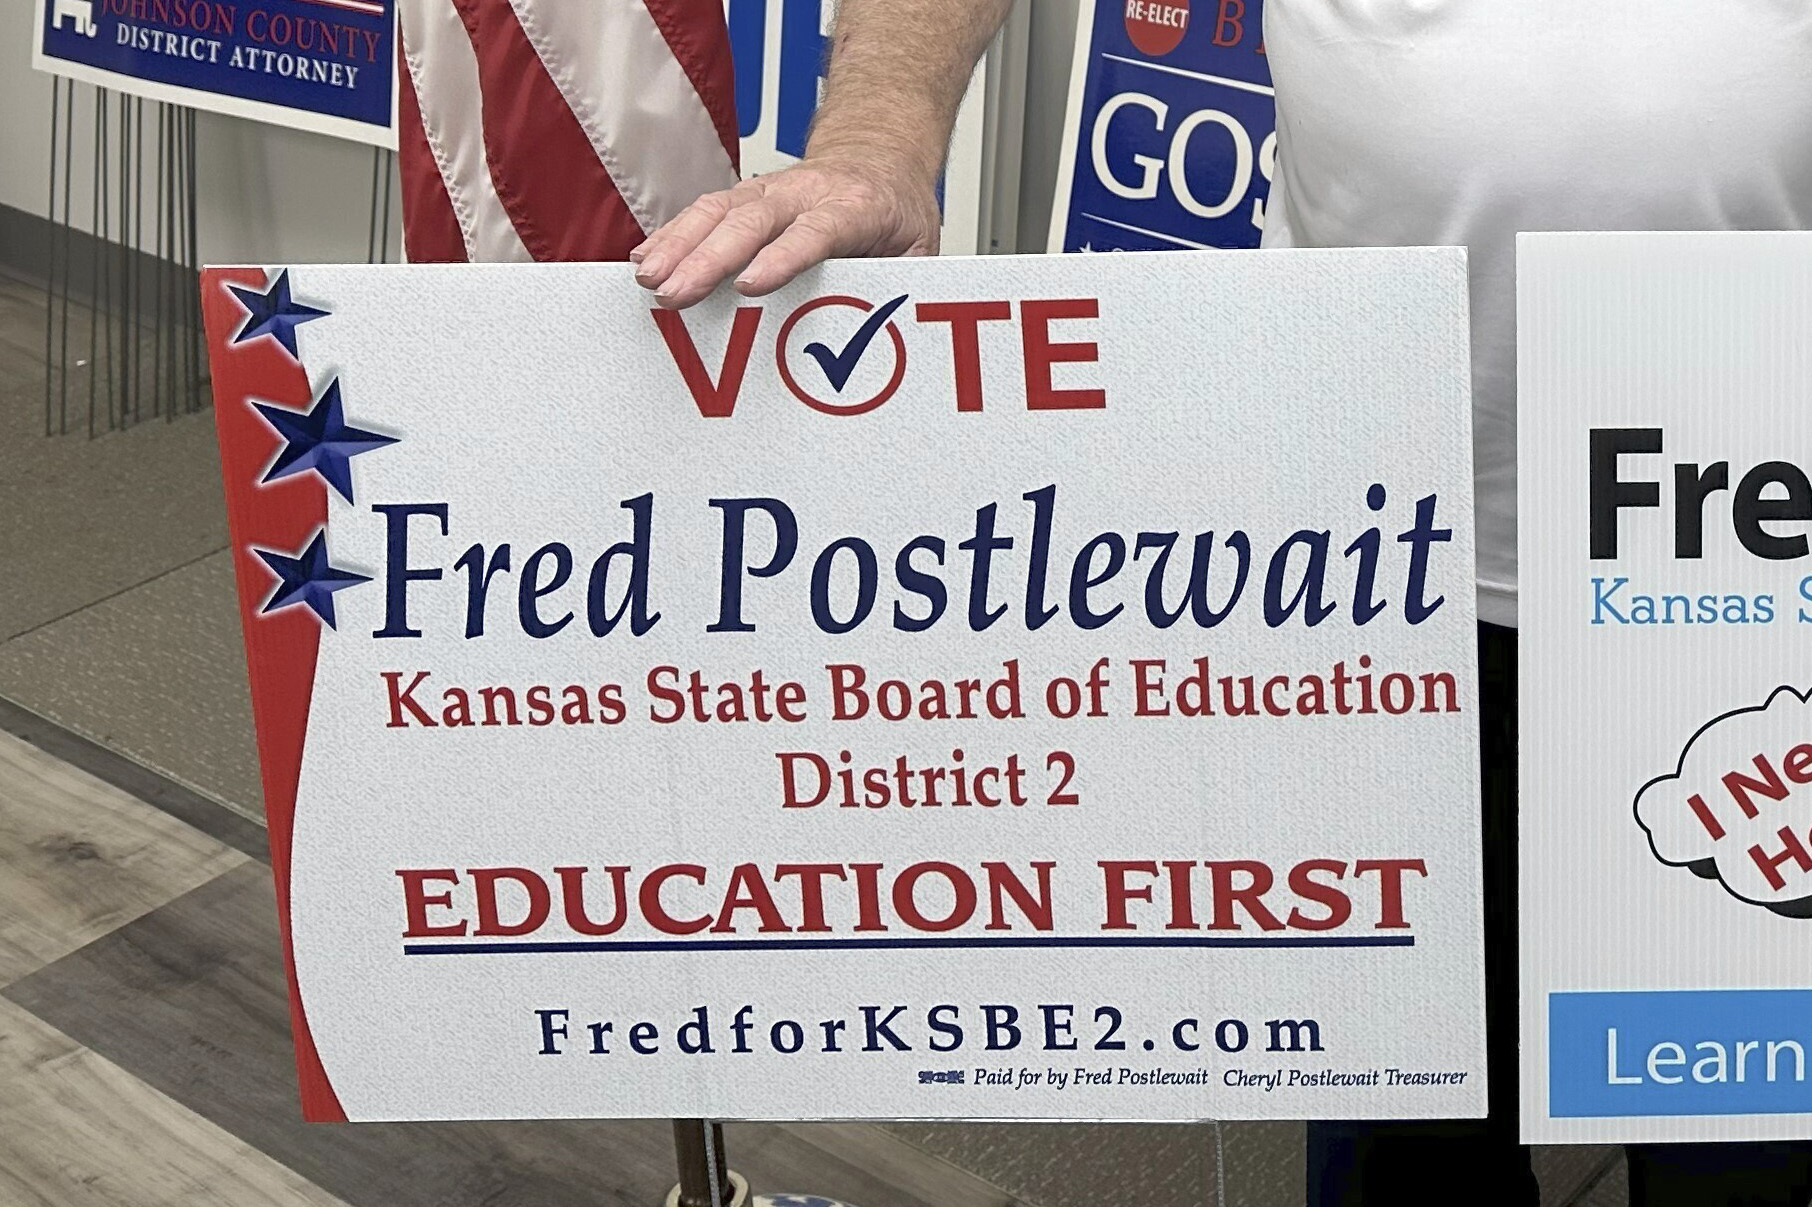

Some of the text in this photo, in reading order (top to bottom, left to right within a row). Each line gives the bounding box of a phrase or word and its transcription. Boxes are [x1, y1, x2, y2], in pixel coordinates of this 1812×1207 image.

[116, 23, 359, 89] DISTRICT ATTORNEY
[246, 8, 381, 63] COUNTY
[650, 293, 1107, 419] VOTE
[372, 482, 1453, 640] Fred Postlewait
[1590, 577, 1775, 625] Kansas
[380, 655, 1461, 729] Kansas State Board of Education
[776, 747, 1080, 810] District 2
[1687, 793, 1727, 842] I
[395, 858, 1429, 939] EDUCATION FIRST
[534, 1003, 1326, 1055] FredforKSBE2.com
[1607, 1027, 1806, 1085] Learn
[973, 1068, 1013, 1085] Paid
[1015, 1068, 1043, 1090] for
[1047, 1068, 1068, 1090] by
[1073, 1067, 1112, 1086] Fred
[1117, 1068, 1208, 1086] Postlewait
[1223, 1069, 1282, 1091] Cheryl
[1287, 1068, 1379, 1087] Postlewait
[1384, 1069, 1468, 1085] Treasurer
